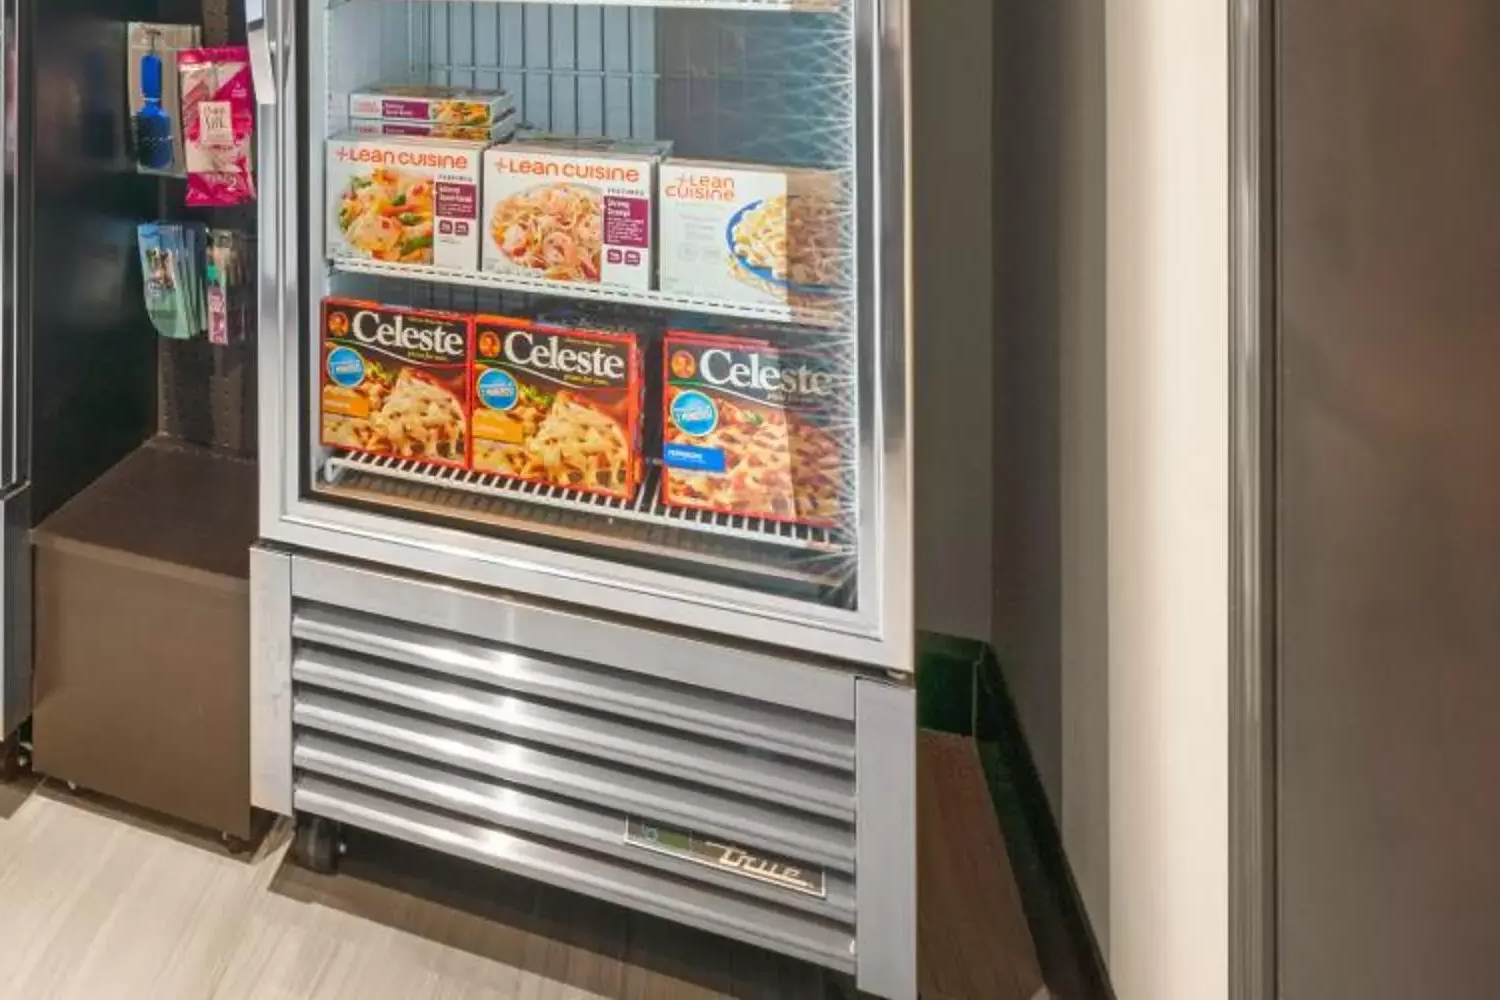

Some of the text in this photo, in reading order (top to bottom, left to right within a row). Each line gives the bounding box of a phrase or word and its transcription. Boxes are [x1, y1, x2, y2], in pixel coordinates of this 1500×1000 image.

[352, 310, 465, 356] Celeste
[504, 330, 625, 379] Celeste
[700, 349, 833, 396] Celeste
[705, 840, 805, 881] True
